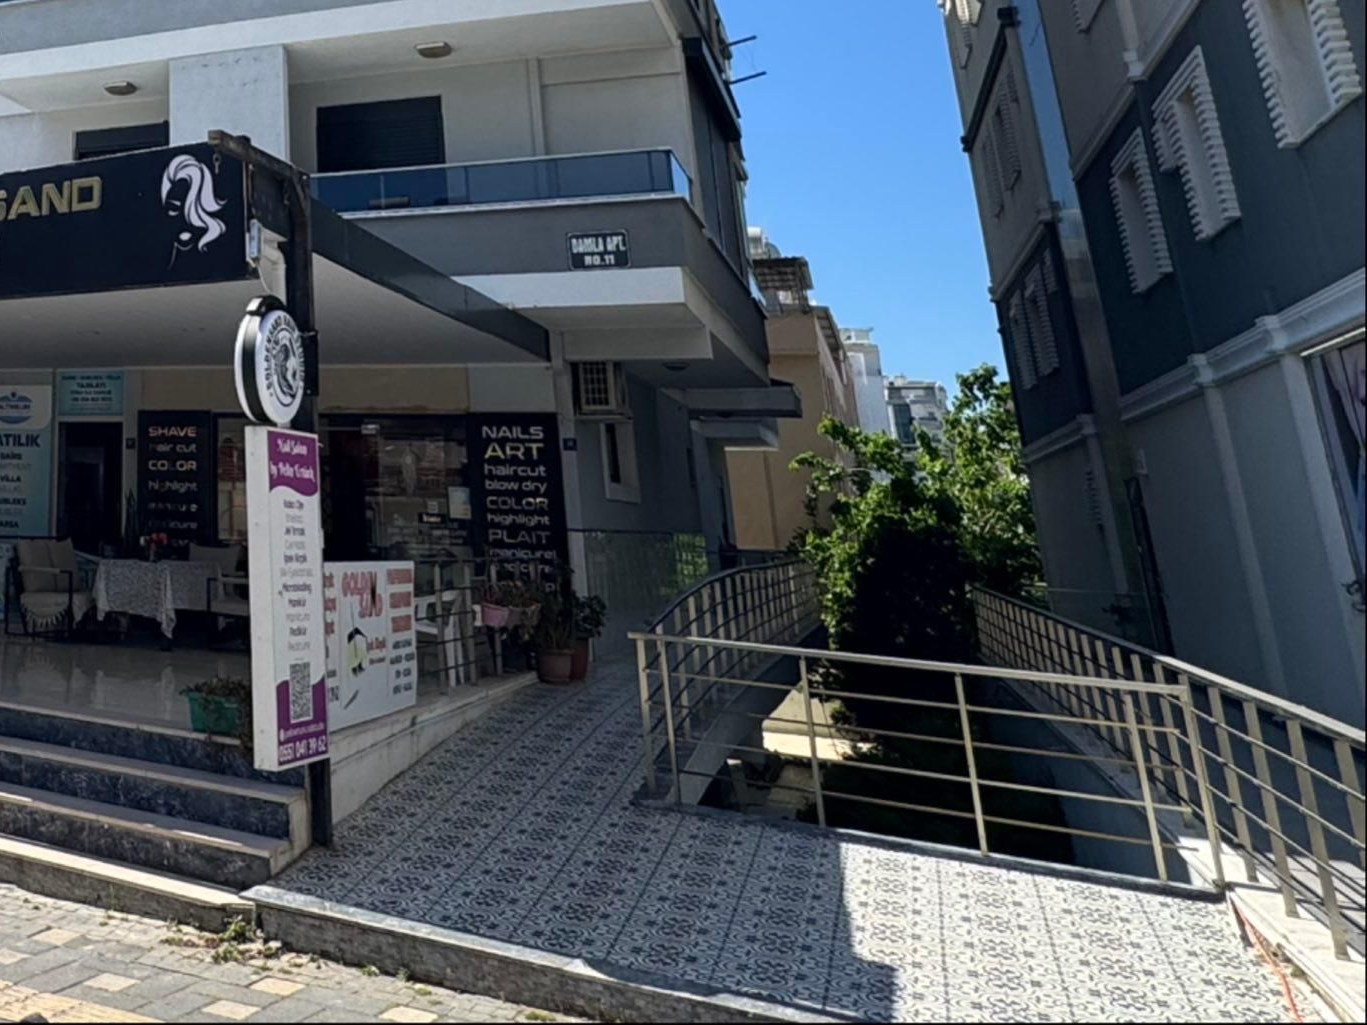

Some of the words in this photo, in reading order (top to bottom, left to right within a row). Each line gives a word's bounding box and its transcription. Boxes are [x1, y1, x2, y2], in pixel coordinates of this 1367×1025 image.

[148, 426, 197, 437] SHAVE
[482, 425, 545, 440] NAILS
[484, 442, 545, 461] ART
[484, 463, 547, 477] haircut
[485, 480, 519, 491] blow
[521, 480, 547, 494] dry
[486, 497, 549, 511] COLOR
[487, 513, 551, 527] highlight
[489, 529, 552, 545] PLAIT
